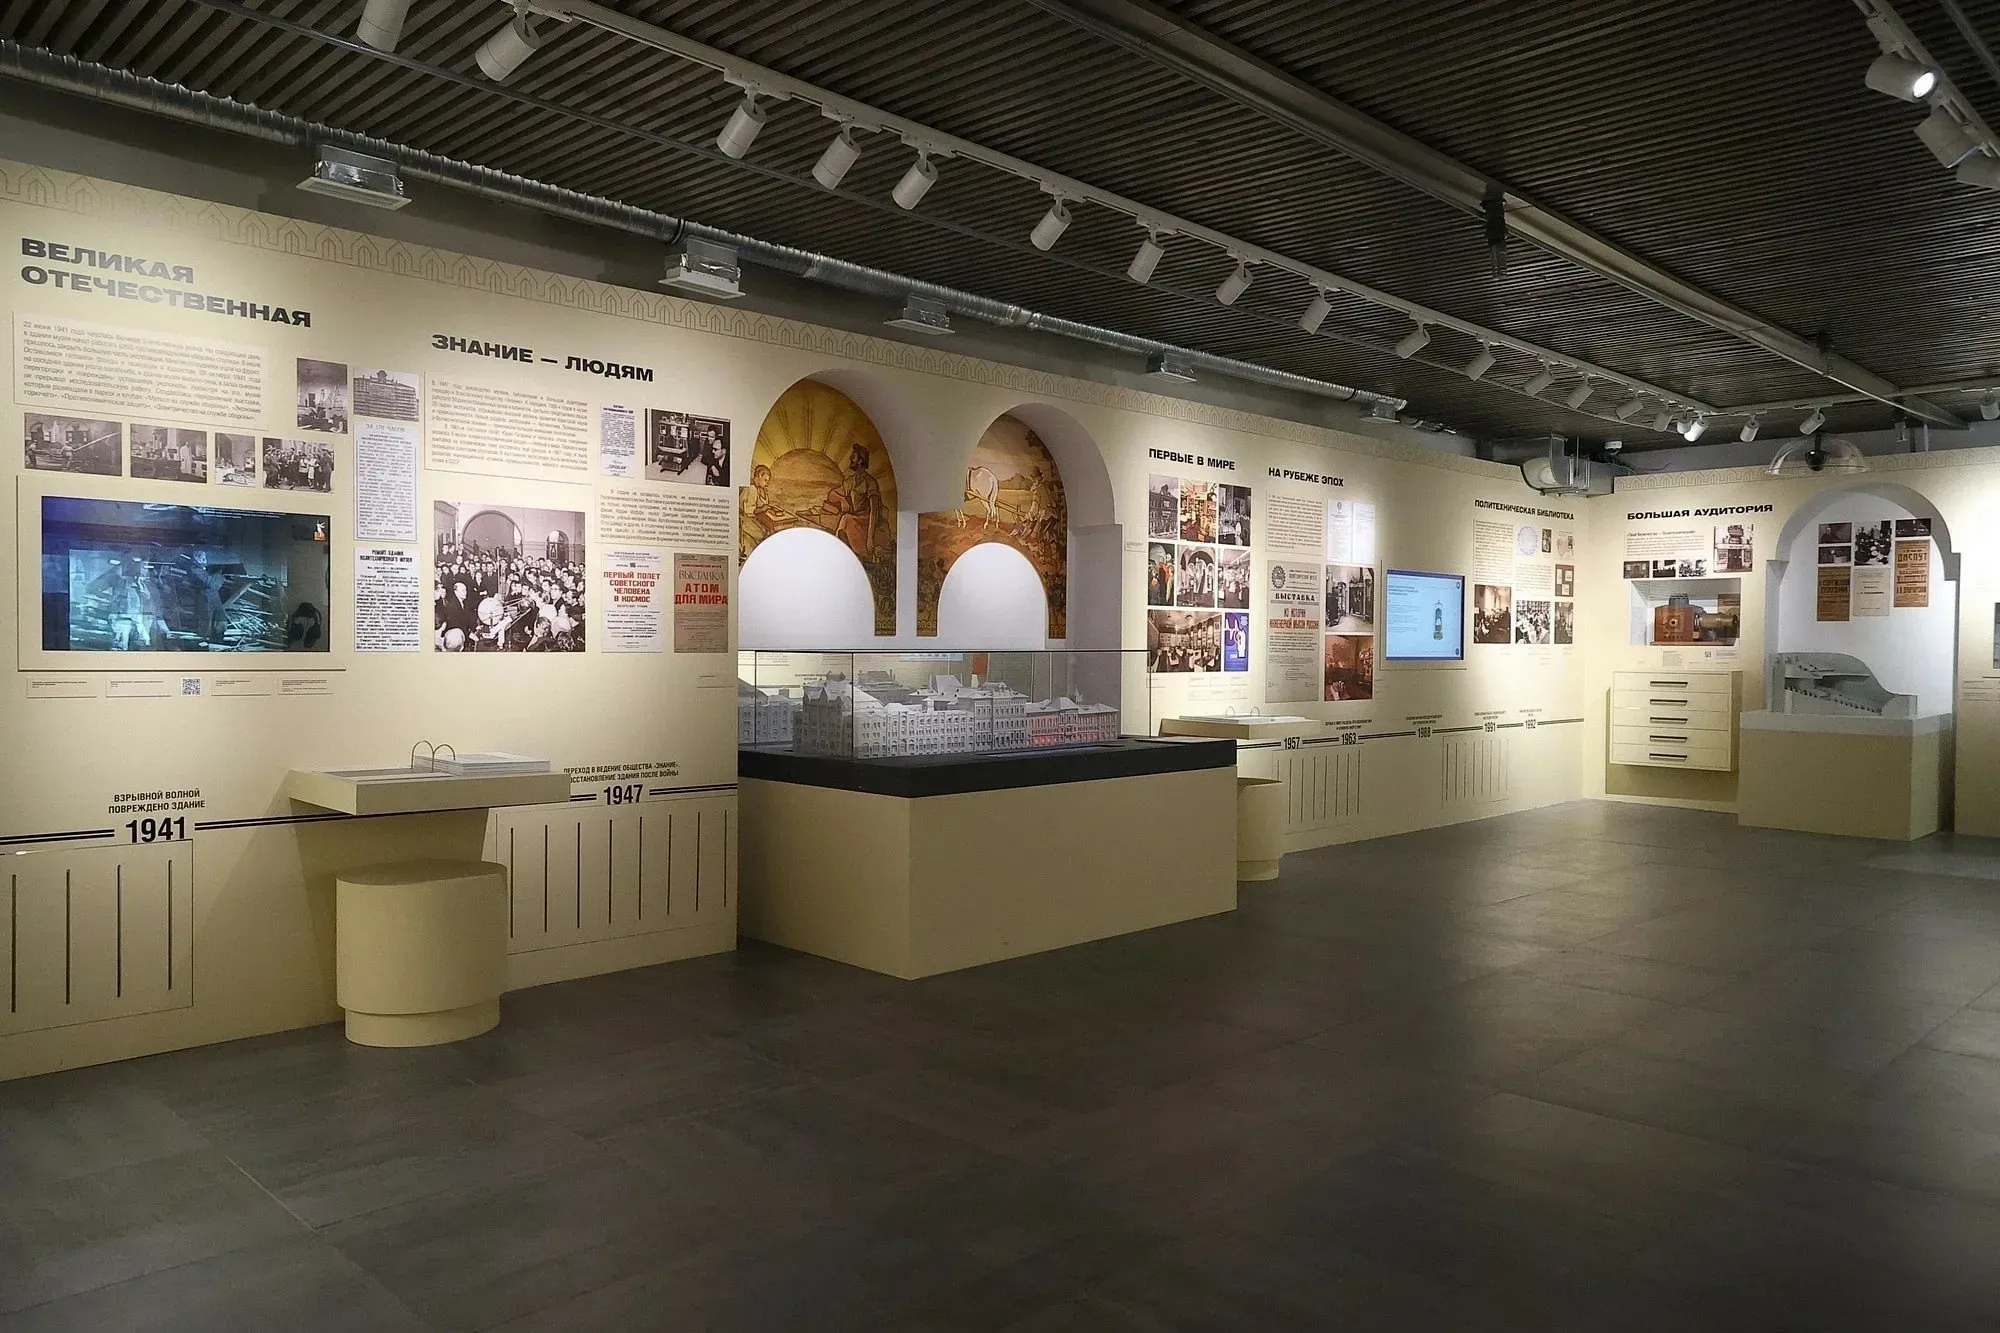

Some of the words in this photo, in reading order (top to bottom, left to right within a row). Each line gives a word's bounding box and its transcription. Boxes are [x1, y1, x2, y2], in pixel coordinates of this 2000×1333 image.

[21, 238, 194, 283] ВЕЛИКАЯ
[21, 266, 311, 327] ОТЕЧЕСТВЕННАЯ
[54, 325, 68, 333] 1941
[432, 334, 533, 363] ЗНАНИЕ
[565, 356, 653, 382] ЛЮДЯМ
[1149, 448, 1194, 464] ПЕРВЫЕ
[1197, 456, 1204, 465] В
[1207, 458, 1235, 470] МИРЕ
[1268, 467, 1281, 477] НА
[1283, 469, 1319, 483] РУБЕЖЕ
[1321, 476, 1344, 487] ЭПОХ
[1475, 500, 1535, 515] ПОЛИТЕХНИЧЕСКАЯ
[1537, 509, 1574, 520] БИБЛИОТЕКА
[1627, 510, 1690, 520] БОЛЬШАЯ
[1694, 504, 1773, 517] АУДИТОРИЯ
[1897, 553, 1927, 562] ДИСПУТ
[679, 570, 724, 580] ВЫСТАВКА
[685, 583, 719, 593] АТОМ
[675, 594, 696, 604] ДЛЯ
[699, 594, 728, 604] МИРА
[1275, 593, 1315, 601] ВЫСТАВКА
[1284, 737, 1300, 749] 1957
[1342, 732, 1357, 745] 1963
[597, 764, 621, 773] ВЕДЕНИЕ
[623, 763, 652, 771] ОБЩЕСТВА
[660, 769, 679, 777] ВОЙНЫ
[114, 790, 163, 802] ВЗРЫВНОЙ
[166, 788, 200, 799] ВОЛНОЙ
[604, 784, 643, 805] 1947
[108, 802, 169, 814] ПОВРЕЖДЕНО
[172, 800, 205, 810] ЗДАНИЕ
[126, 817, 185, 843] 1941
